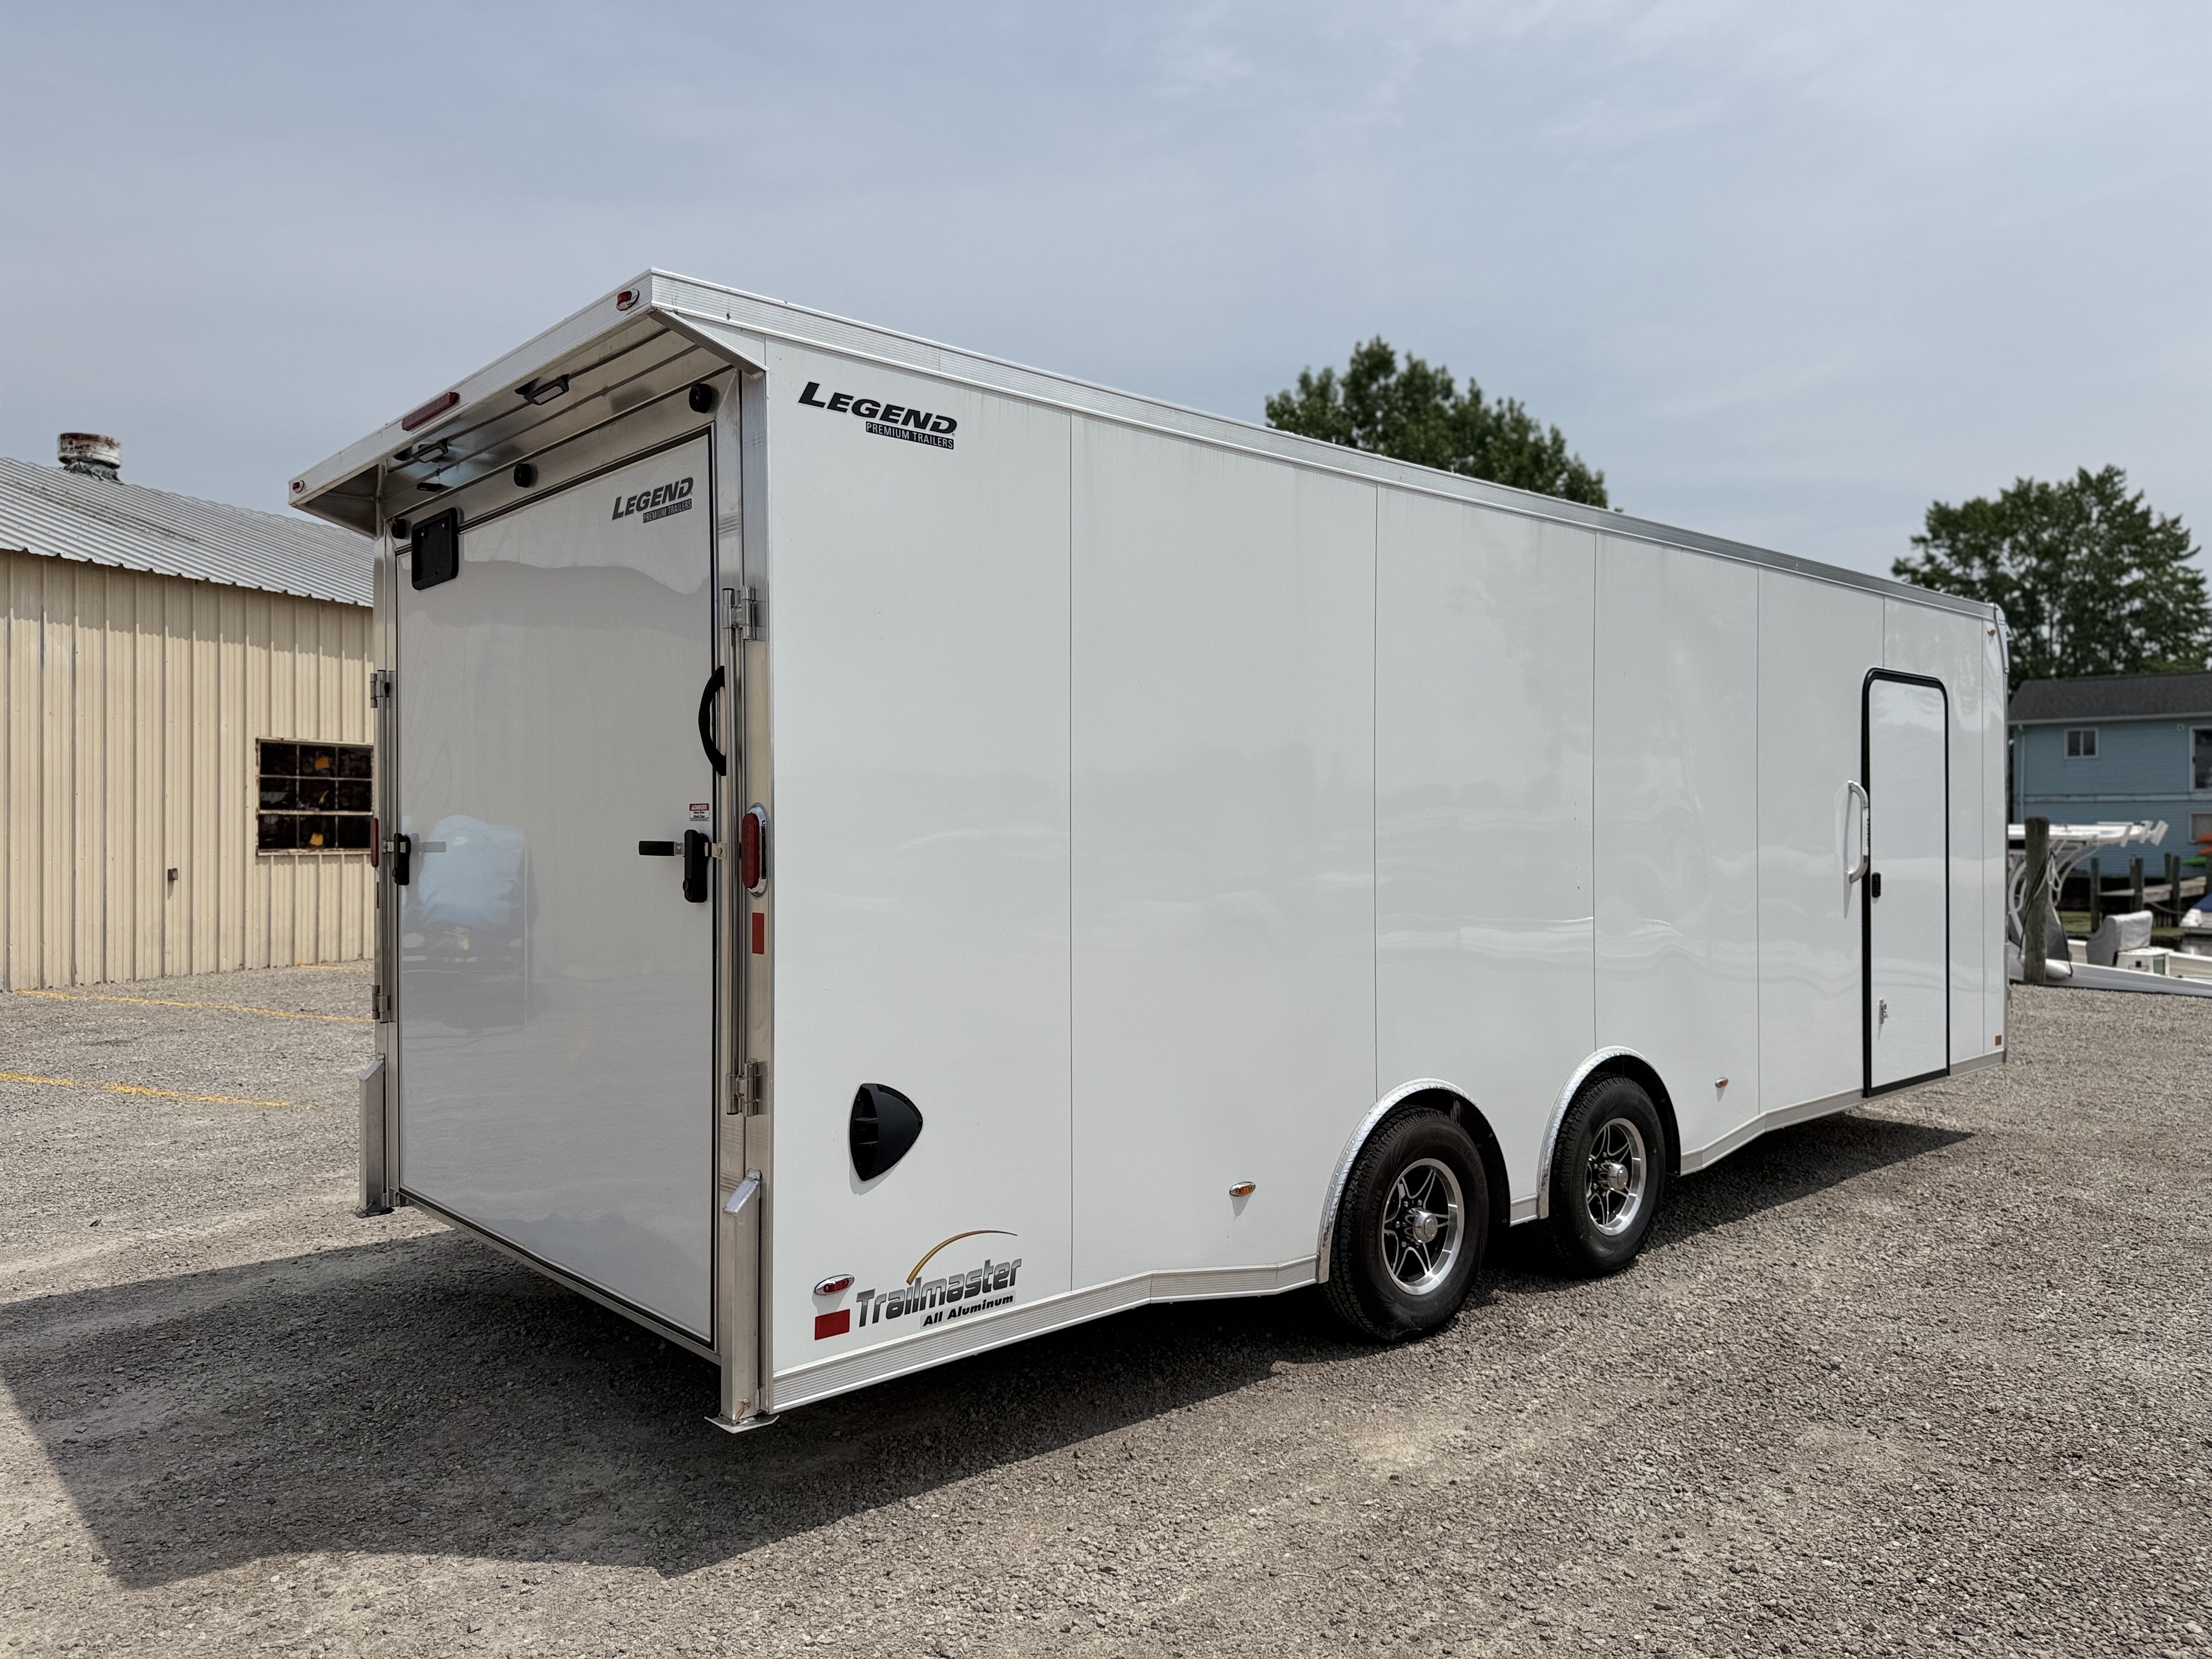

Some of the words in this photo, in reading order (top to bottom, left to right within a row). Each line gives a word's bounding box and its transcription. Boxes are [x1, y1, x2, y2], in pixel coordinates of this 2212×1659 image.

[798, 381, 958, 434] LEGEND
[866, 421, 910, 440] PREMIUM
[912, 431, 953, 449] TRAILERS
[612, 477, 693, 521] LEGEND
[643, 508, 667, 522] PREMIUM
[668, 499, 692, 515] TRAILERS
[856, 1258, 1023, 1328] Trailmaster
[922, 1311, 944, 1327] All
[947, 1295, 1014, 1321] Aluminum
